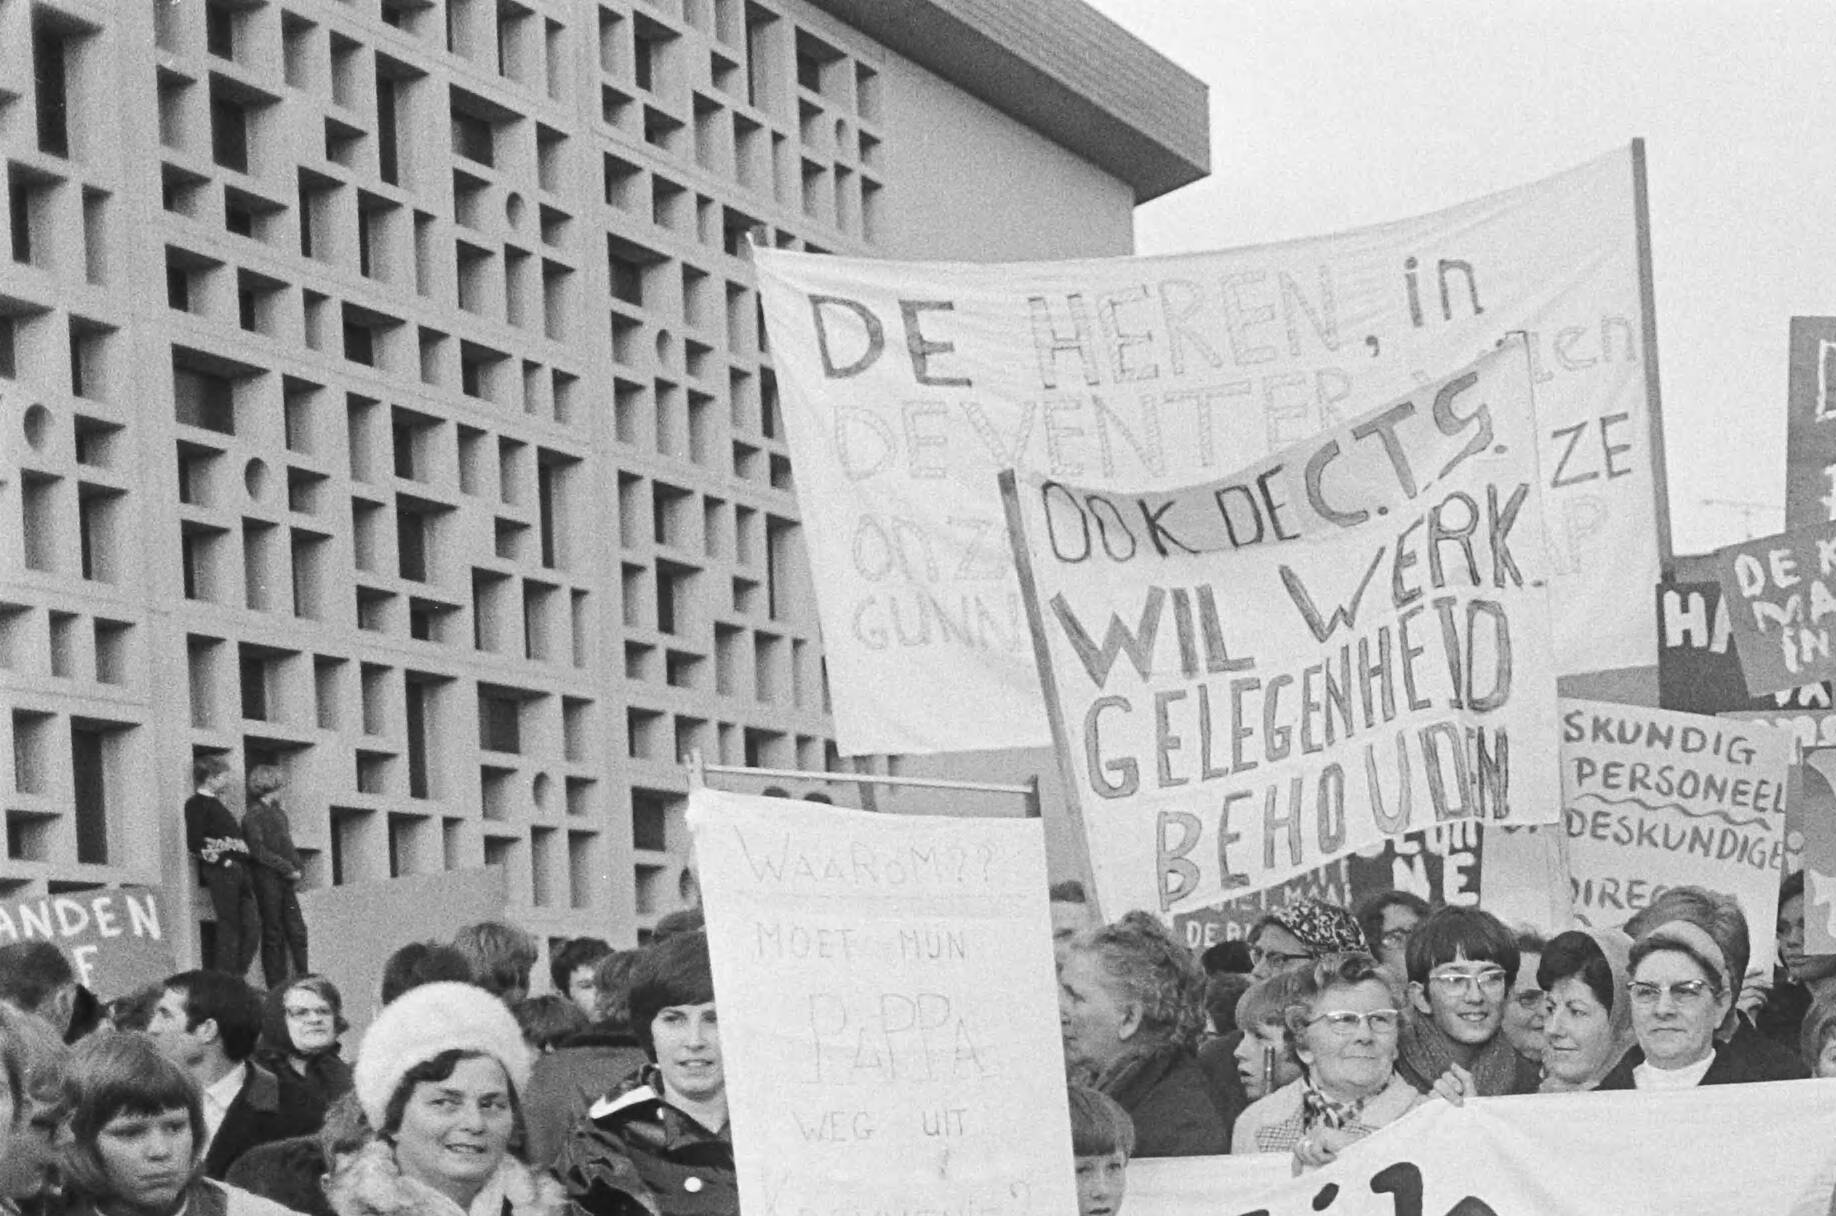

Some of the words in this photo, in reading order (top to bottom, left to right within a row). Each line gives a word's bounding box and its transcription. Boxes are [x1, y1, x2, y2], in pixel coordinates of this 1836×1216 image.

[808, 294, 973, 388] DE
[1403, 253, 1486, 330] in
[1041, 478, 1200, 565] OOK
[1050, 582, 1257, 690] WIL
[1562, 709, 1757, 765] SKUNDIG
[1570, 755, 1786, 815] PERSONEEL
[755, 921, 854, 960] MOET
[804, 990, 990, 1086] PAPPA
[792, 1108, 877, 1143] WEG
[920, 1107, 969, 1139] UIT
